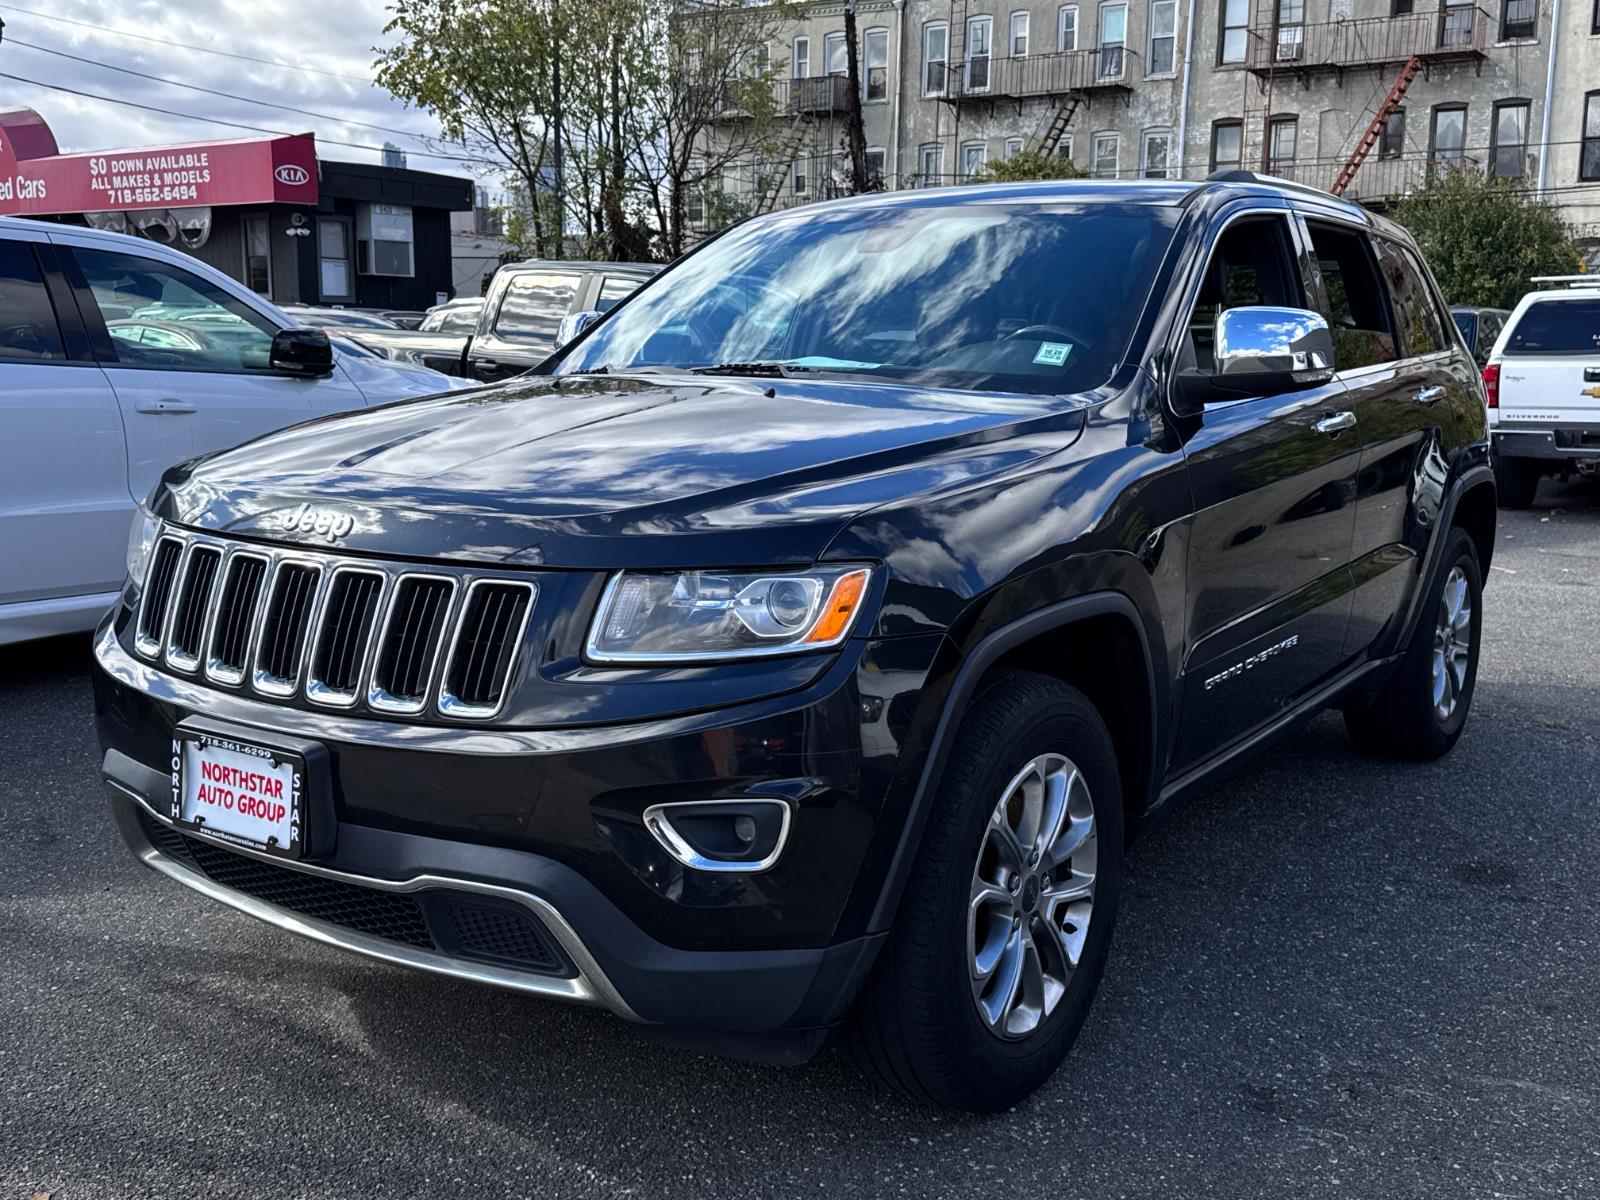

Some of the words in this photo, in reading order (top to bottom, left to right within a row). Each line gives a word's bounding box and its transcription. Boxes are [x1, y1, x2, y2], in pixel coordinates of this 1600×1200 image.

[89, 157, 106, 175] $0
[111, 160, 143, 173] DOWN
[146, 153, 209, 170] AVAILABLE
[16, 175, 46, 200] Cars
[91, 176, 111, 190] ALL
[113, 173, 150, 189] MAKES
[153, 173, 161, 186] &
[163, 169, 210, 184] MODELS
[282, 502, 355, 543] Jeep
[200, 735, 272, 759] 718-361-6299
[201, 760, 284, 800] NORTHSTAR
[197, 783, 234, 809] AUTO
[237, 794, 286, 824] GROUP
